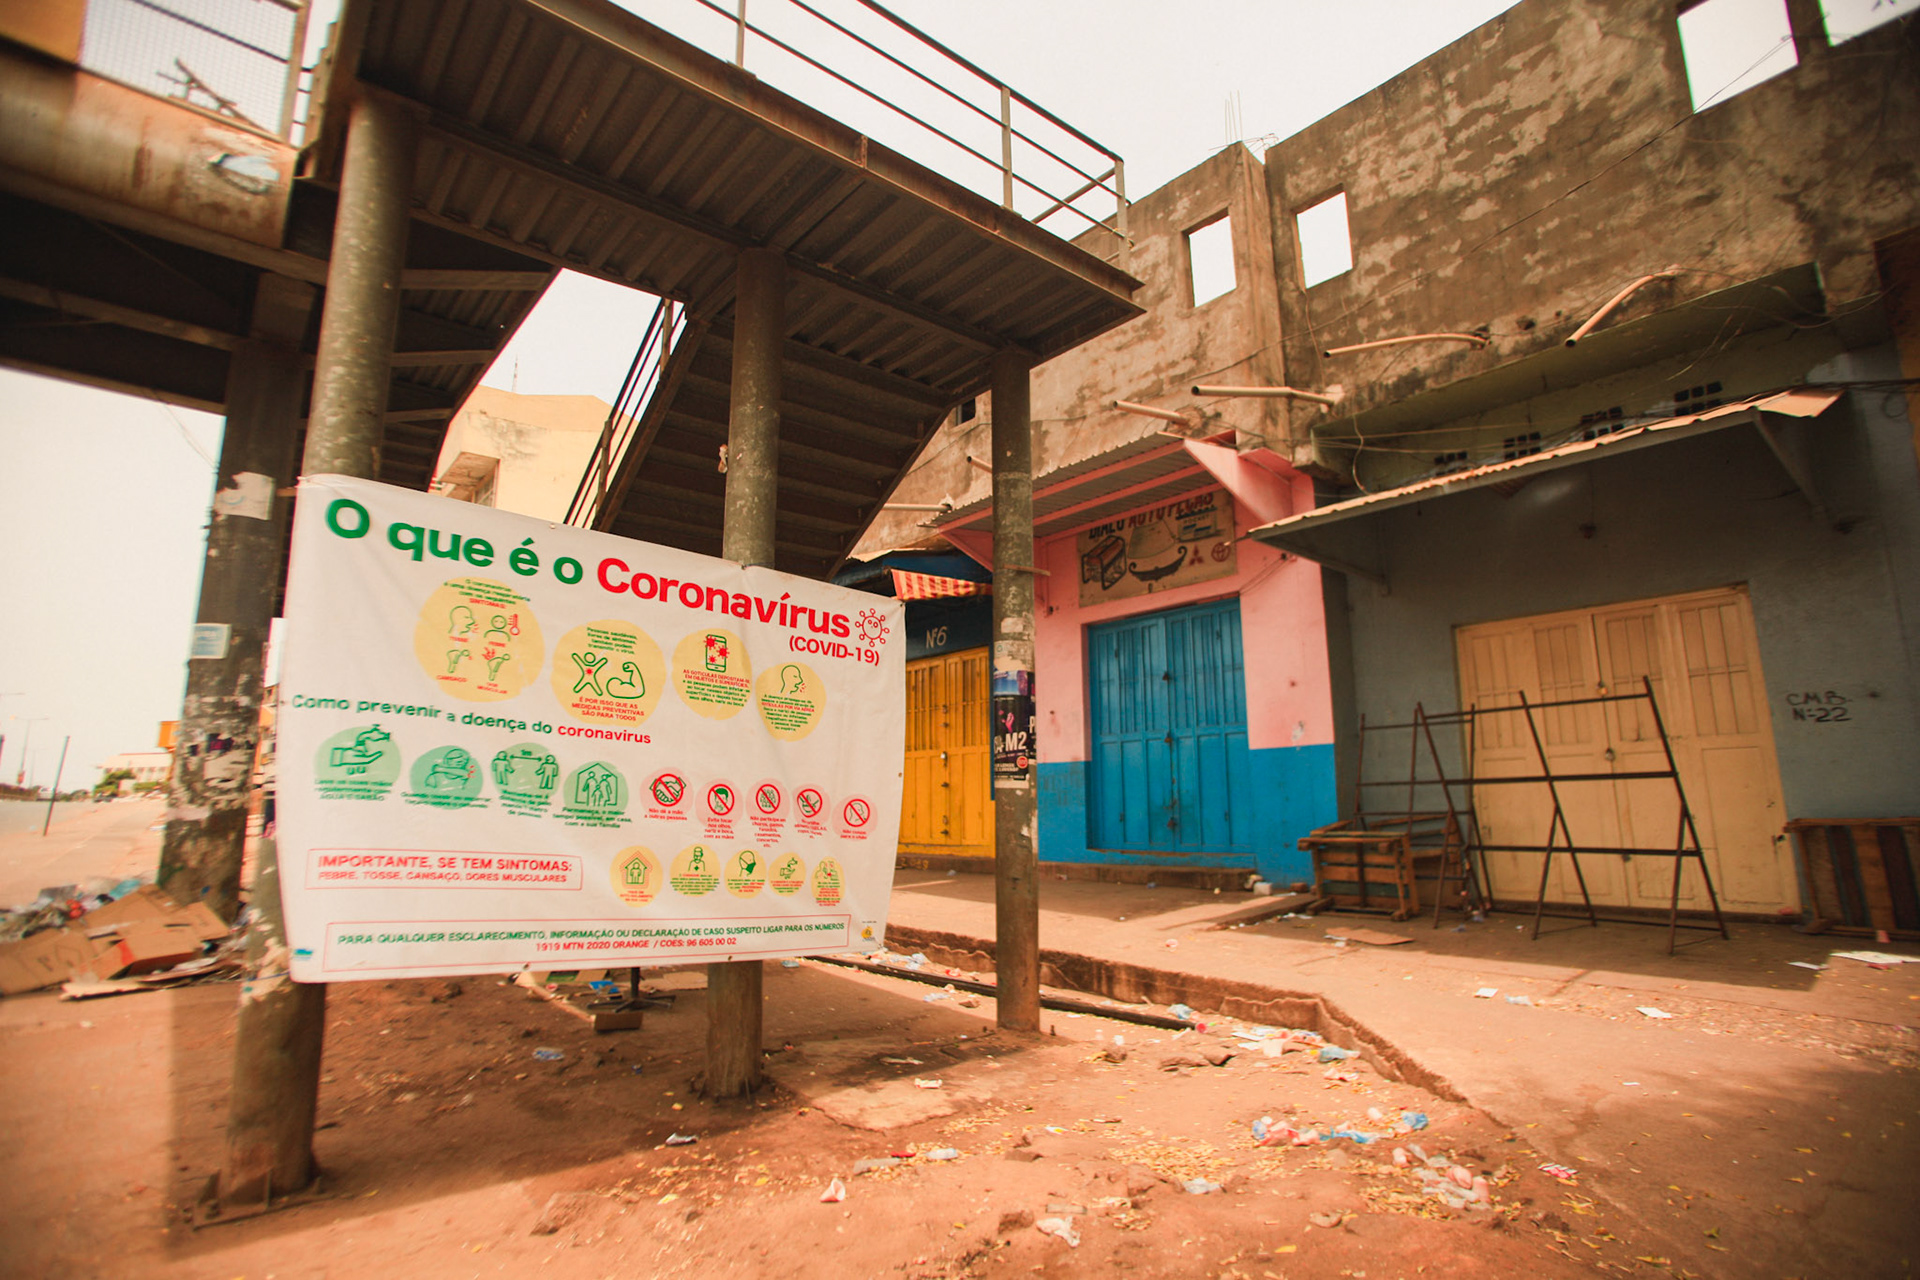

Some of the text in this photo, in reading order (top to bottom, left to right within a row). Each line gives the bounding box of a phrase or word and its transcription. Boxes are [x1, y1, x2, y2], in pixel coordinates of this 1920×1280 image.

[325, 499, 850, 638] O que é o Coronavírus
[789, 635, 880, 666] (COVID-19)
[291, 692, 552, 734] Como prevenir a doença do
[571, 702, 645, 716] MEDIDAS PREVENTIVAS
[581, 708, 595, 716] SÃO
[616, 713, 637, 721] TODOS
[558, 726, 651, 743] coronavirus
[318, 854, 572, 872] IMPORTANTE, SE TEM SINTOMAS:
[466, 873, 499, 881] DORES
[502, 874, 567, 882] MUSCULARES
[337, 932, 373, 945] PARA
[376, 933, 444, 945] QUALQUER
[448, 930, 546, 942] ESCLARECIMENTO,
[549, 930, 614, 940] INFORMAÇÃO
[616, 930, 629, 938] OU
[631, 928, 691, 937] DECLARAÇÃO
[691, 928, 701, 936] DE
[703, 927, 725, 936] CASO
[726, 926, 763, 935] SUSPEITO
[763, 925, 784, 934] LIGAR
[537, 943, 561, 951] 1919
[563, 942, 585, 950] MTN
[586, 941, 611, 949] 2020
[612, 940, 649, 948] ORANGE
[660, 939, 684, 947] COES:
[699, 938, 714, 946] 605
[727, 937, 737, 945] 02
